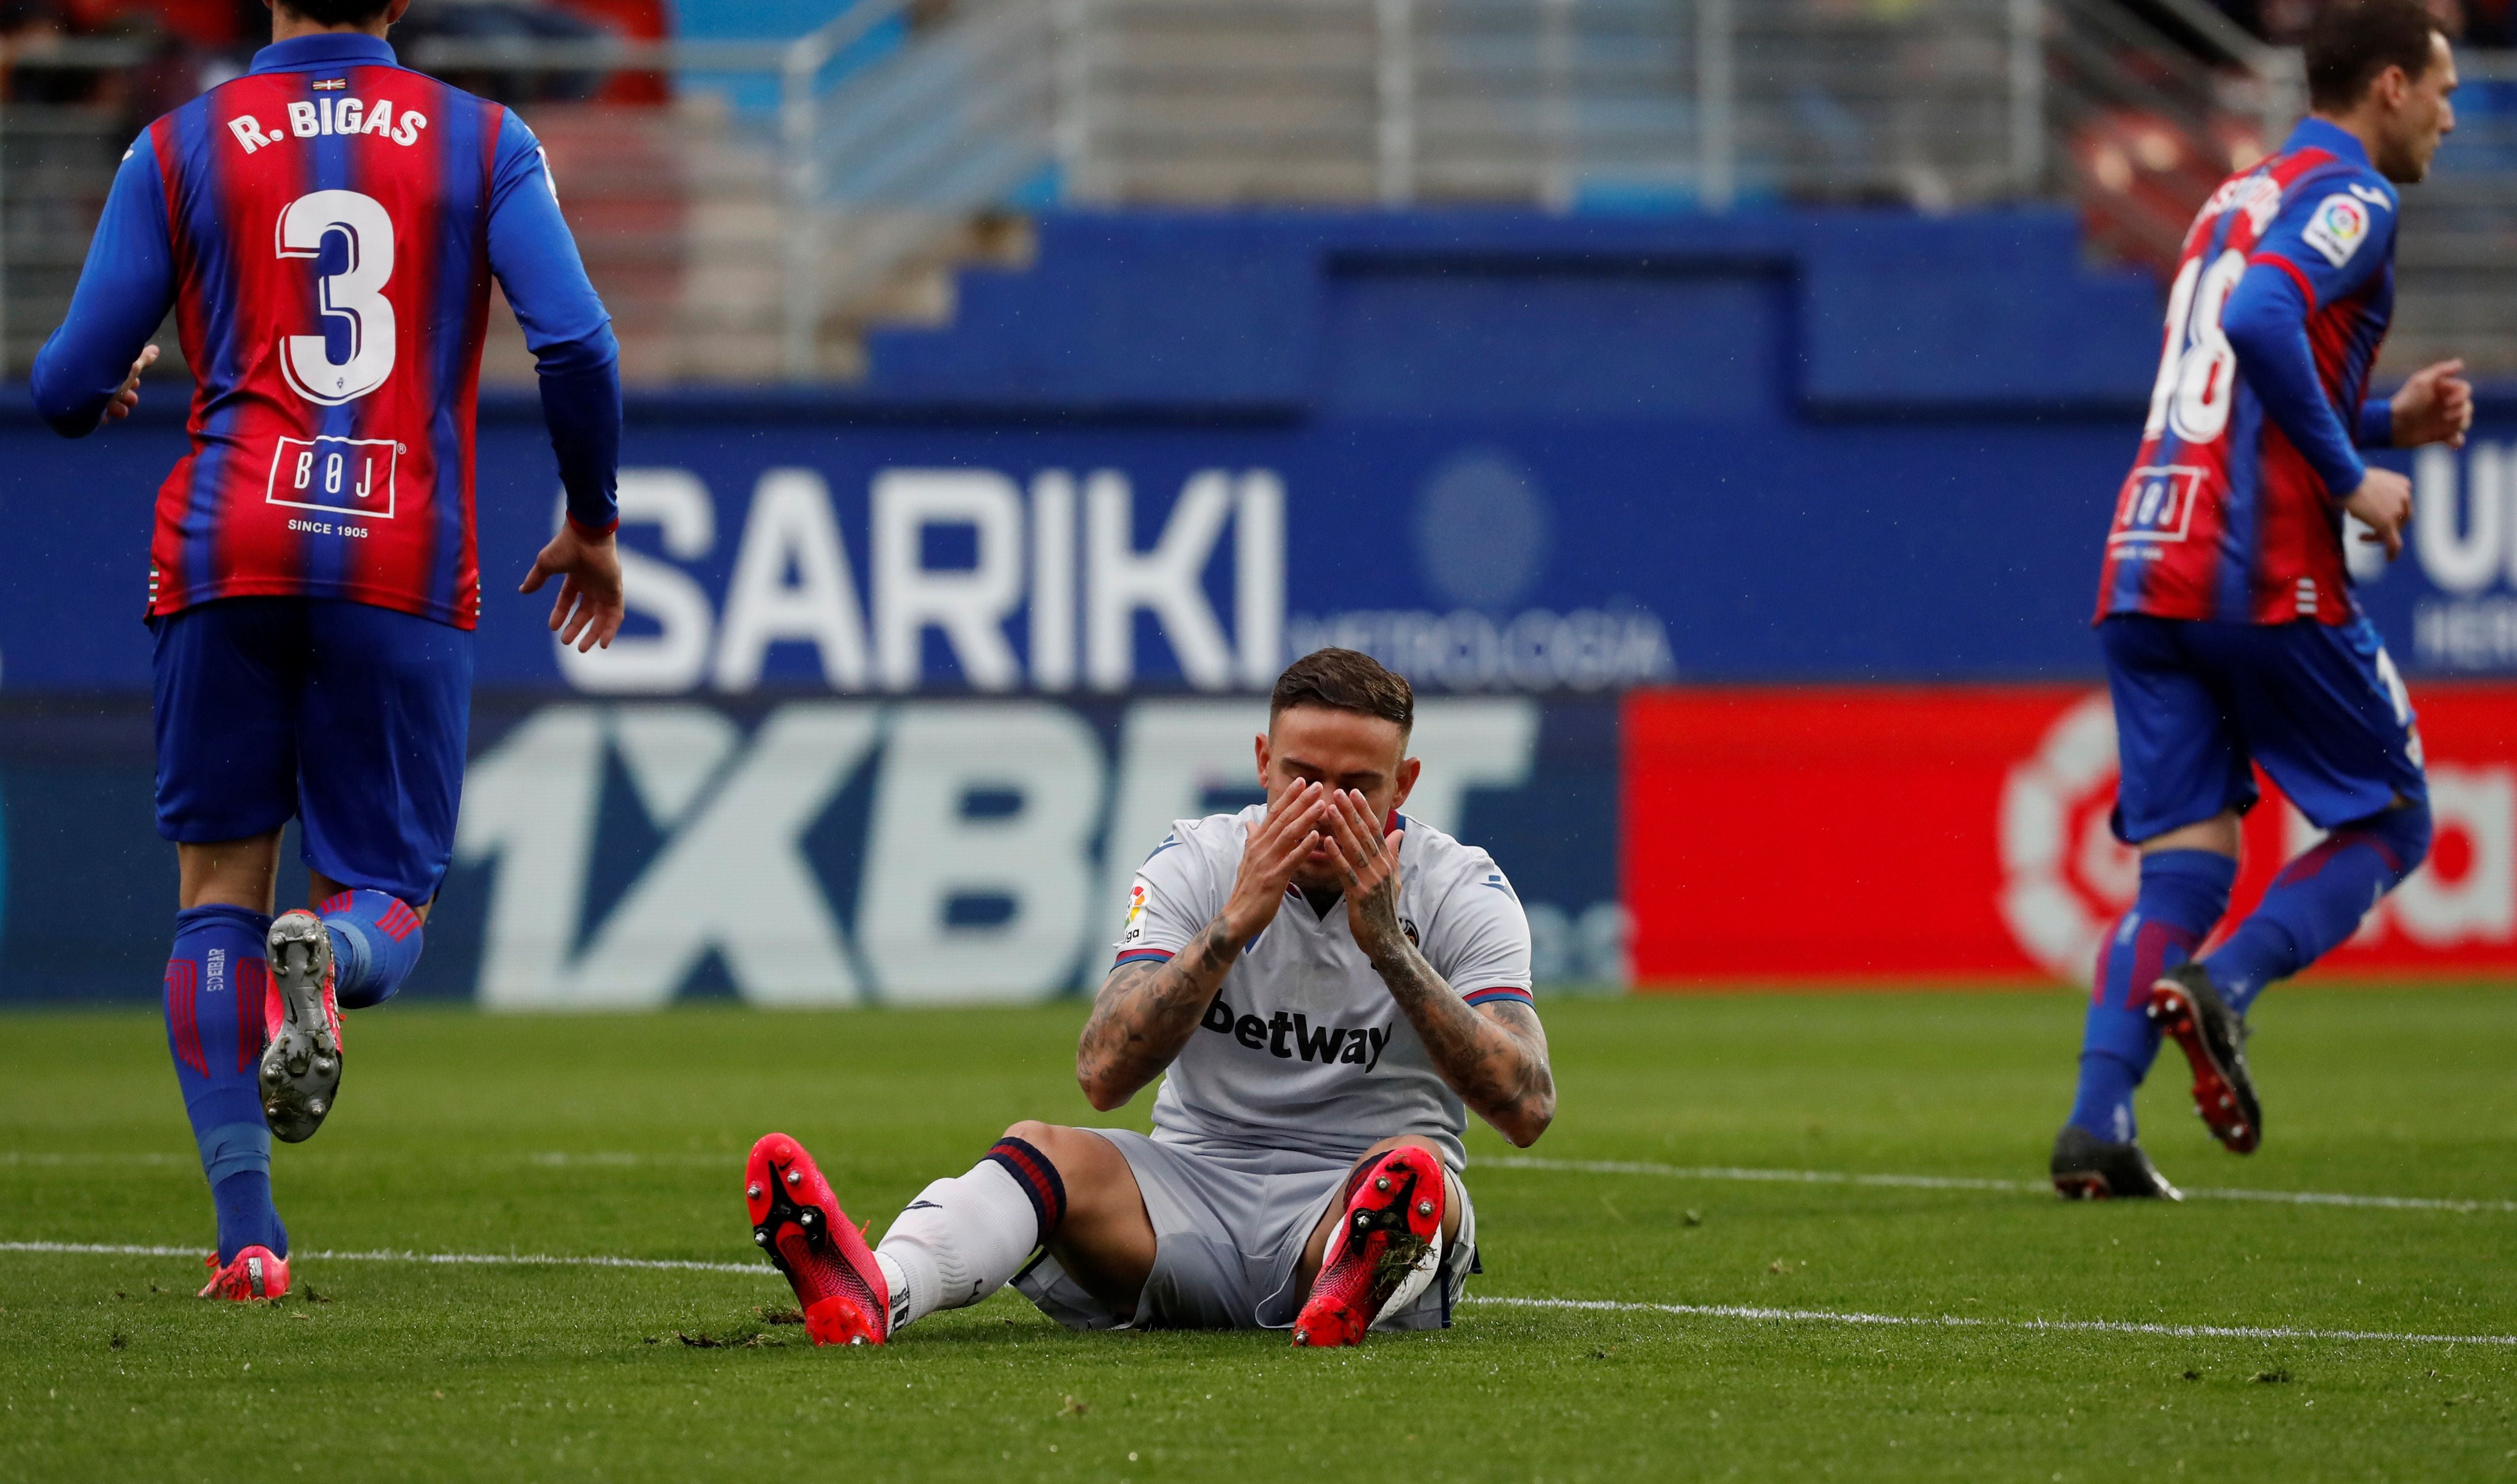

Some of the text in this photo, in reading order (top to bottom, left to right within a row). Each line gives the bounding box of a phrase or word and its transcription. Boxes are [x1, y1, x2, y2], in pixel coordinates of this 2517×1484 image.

[227, 97, 427, 155] R. BIGAS
[274, 189, 397, 407] 3
[287, 519, 368, 538] SINCE 1905
[553, 466, 1289, 696] SARIKI
